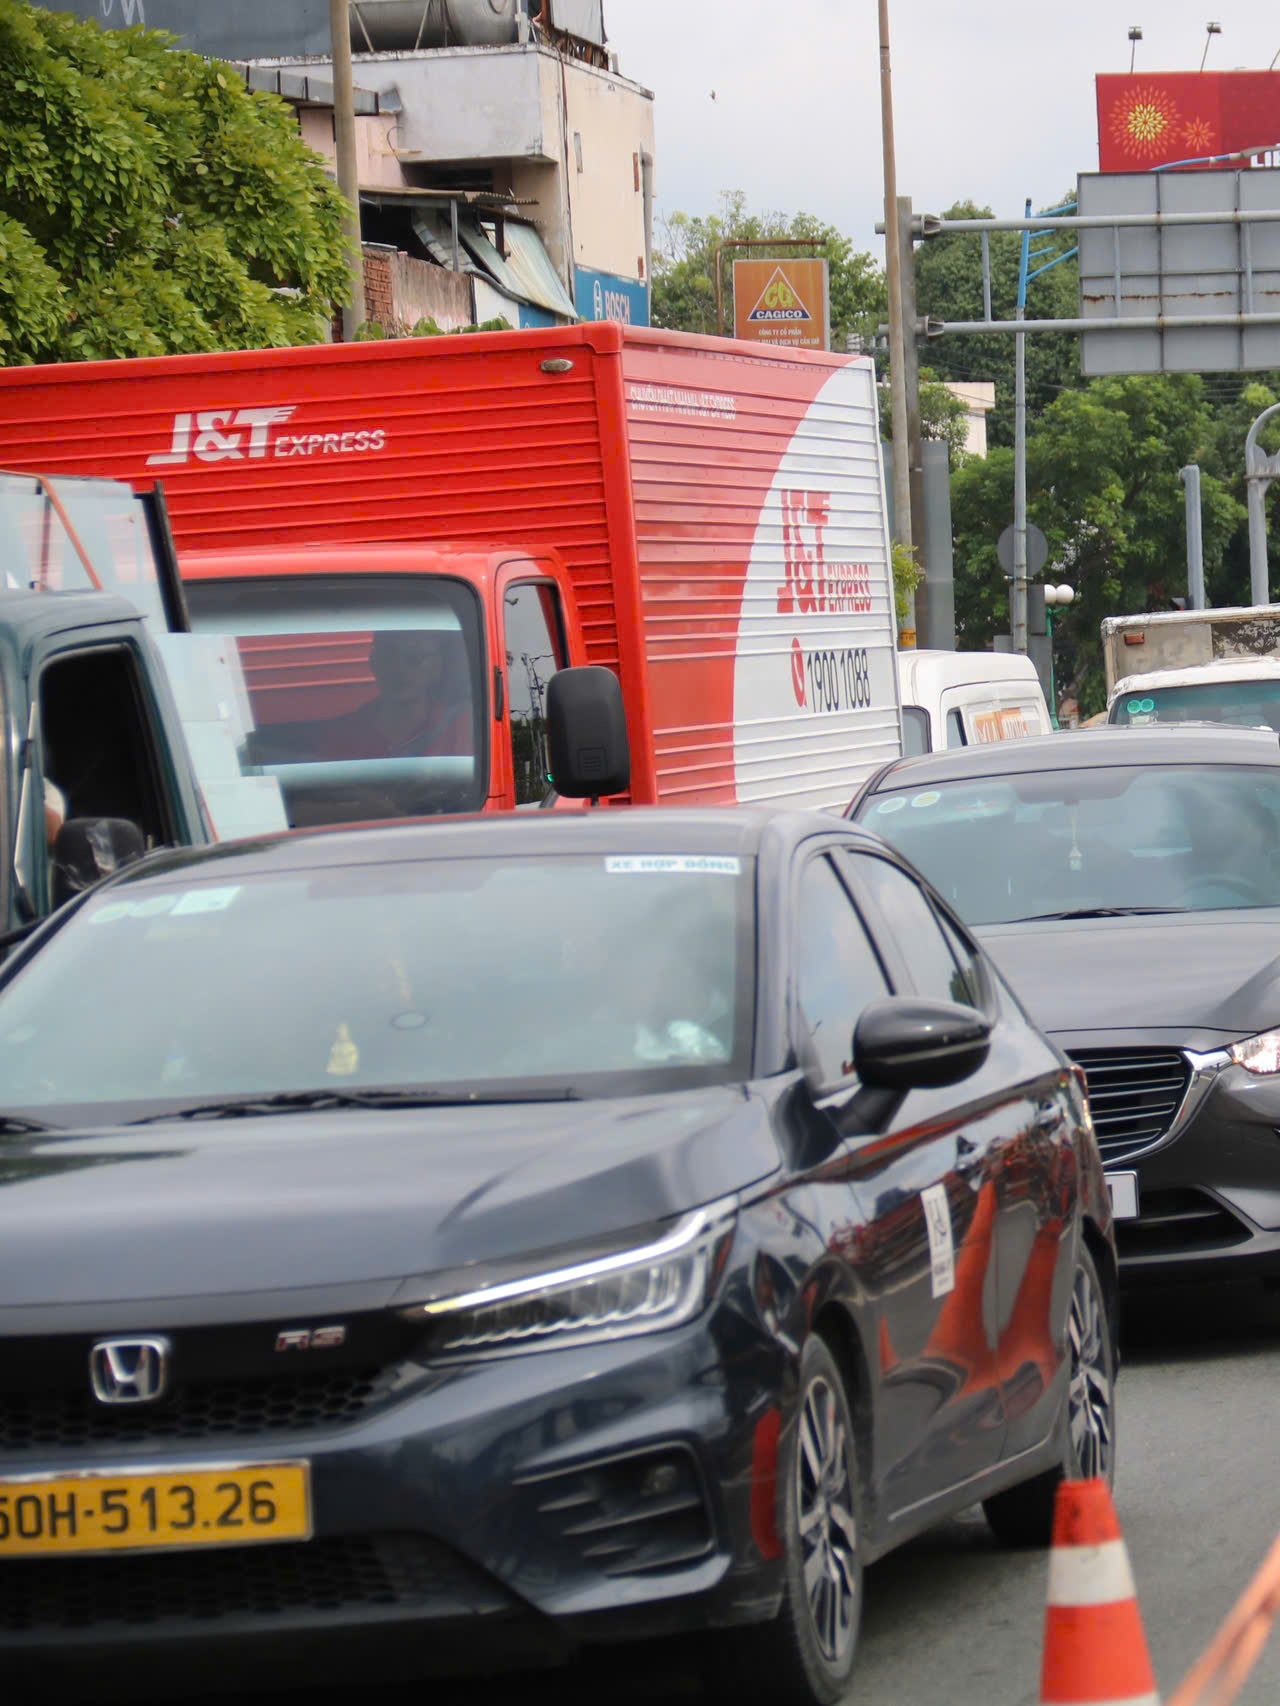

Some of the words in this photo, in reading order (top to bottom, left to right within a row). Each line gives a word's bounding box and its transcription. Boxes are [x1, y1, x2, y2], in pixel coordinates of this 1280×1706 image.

[605, 290, 631, 325] BOSCH
[756, 310, 803, 319] CAGICO
[146, 405, 297, 465] J&T
[275, 429, 386, 457] EXPRESS
[826, 563, 873, 612] EXPRESS
[807, 651, 840, 713] 1900
[840, 648, 870, 708] 1088
